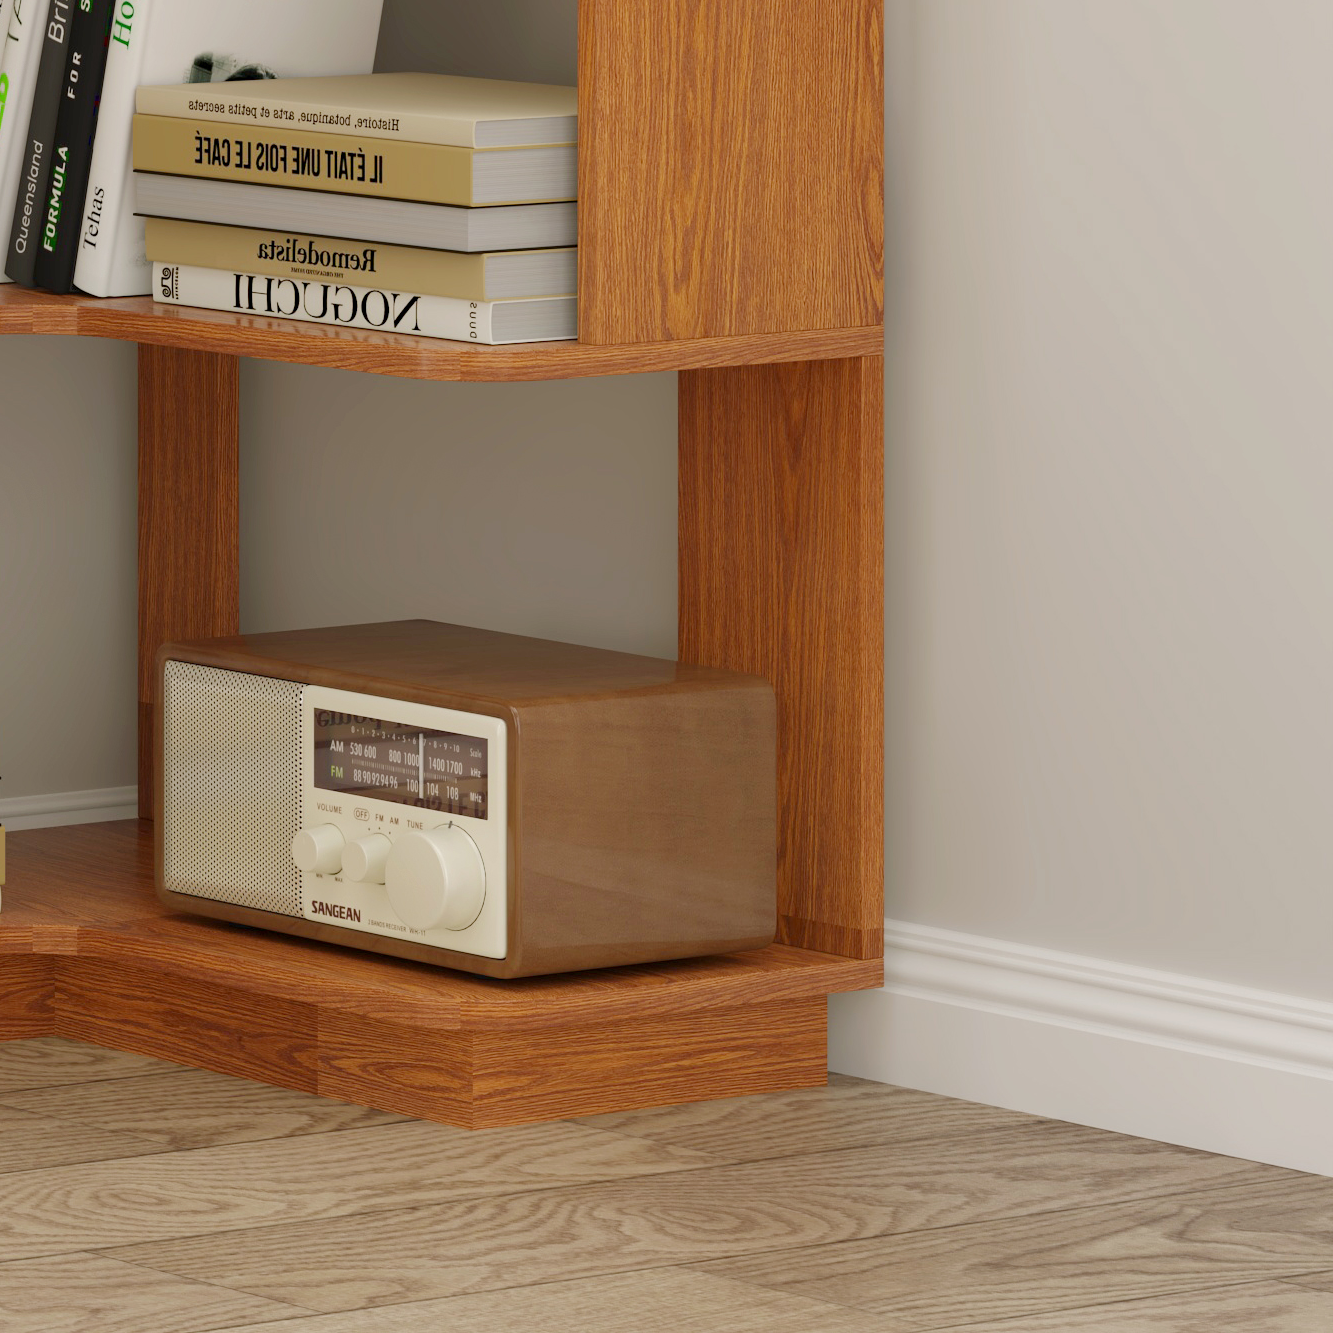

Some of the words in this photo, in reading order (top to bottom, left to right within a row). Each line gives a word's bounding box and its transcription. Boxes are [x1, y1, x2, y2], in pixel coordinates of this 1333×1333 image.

[15, 139, 44, 254] Queensland
[329, 738, 345, 754] AM
[330, 765, 344, 779] FM
[316, 802, 342, 815] VOLUME
[406, 819, 424, 831] TUNE
[311, 900, 361, 923] SANGEAN
